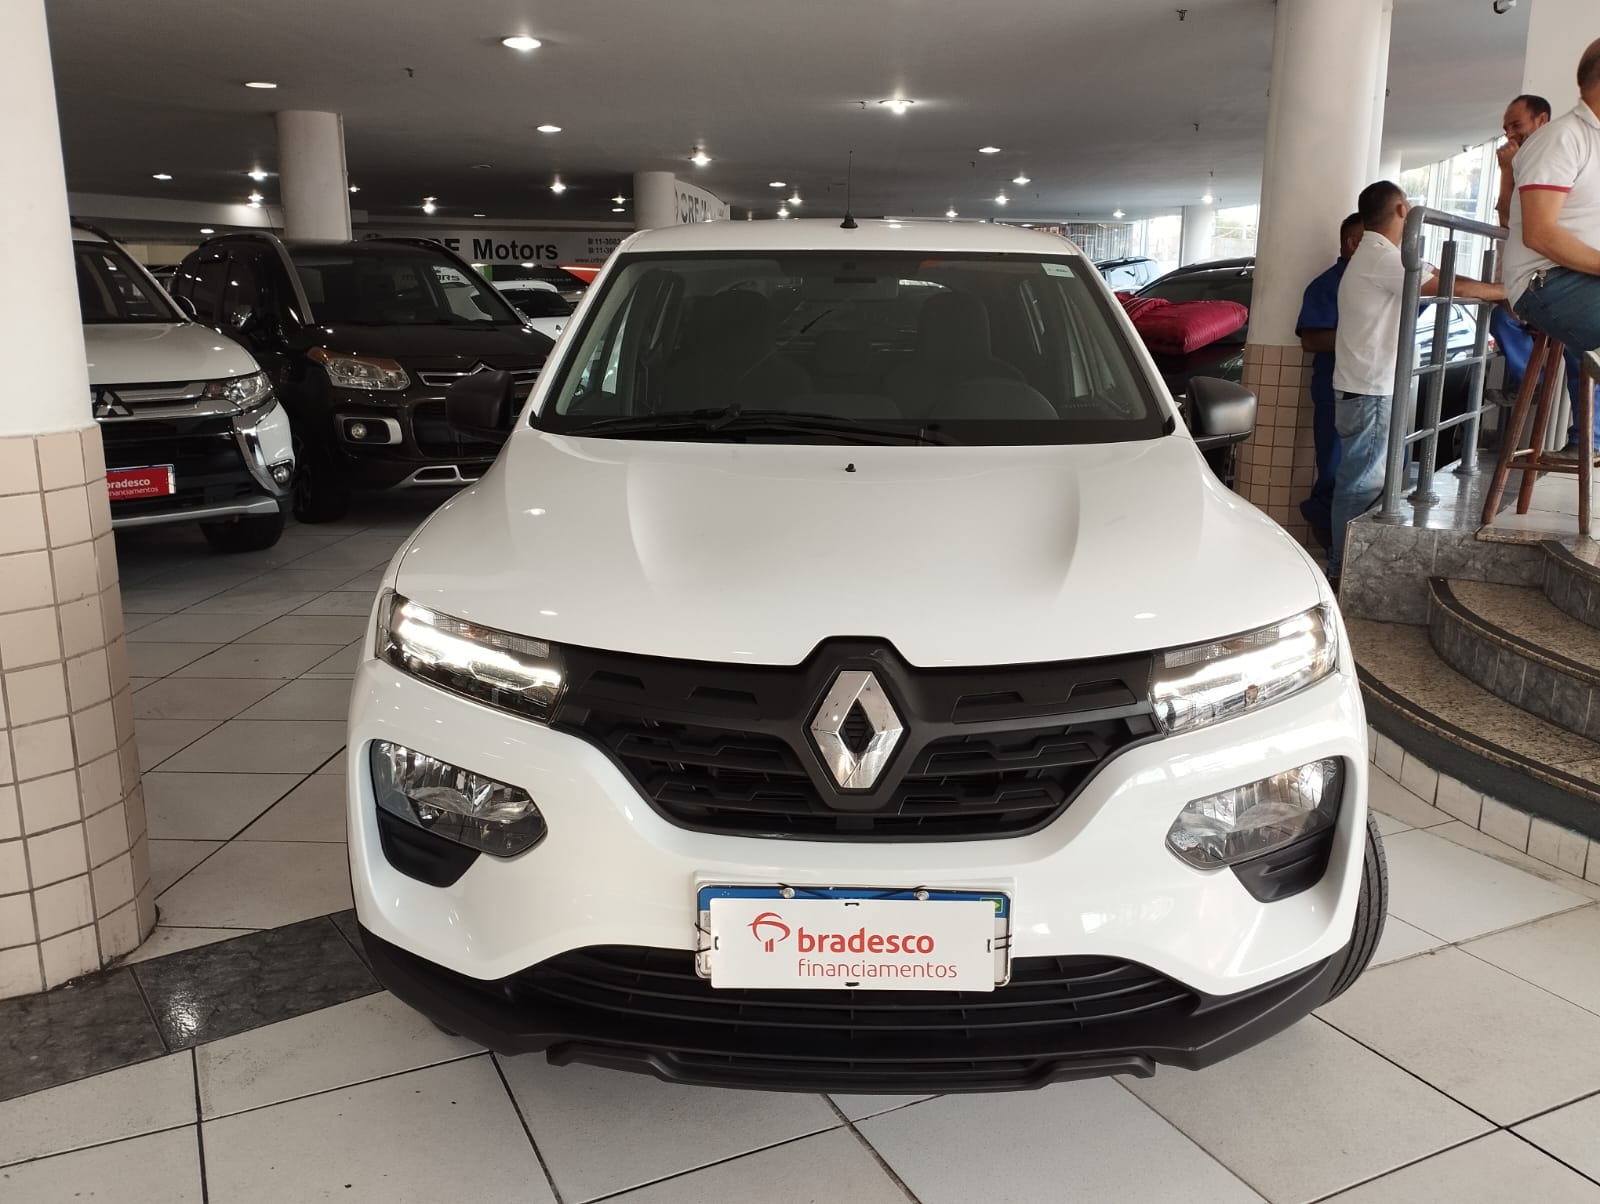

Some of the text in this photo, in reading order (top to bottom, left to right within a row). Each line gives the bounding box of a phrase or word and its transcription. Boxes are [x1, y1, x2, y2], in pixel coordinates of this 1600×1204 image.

[472, 237, 559, 261] Motors
[108, 486, 159, 497] nanciamentos
[797, 926, 935, 954] bradesco
[797, 957, 958, 978] financiamentos
